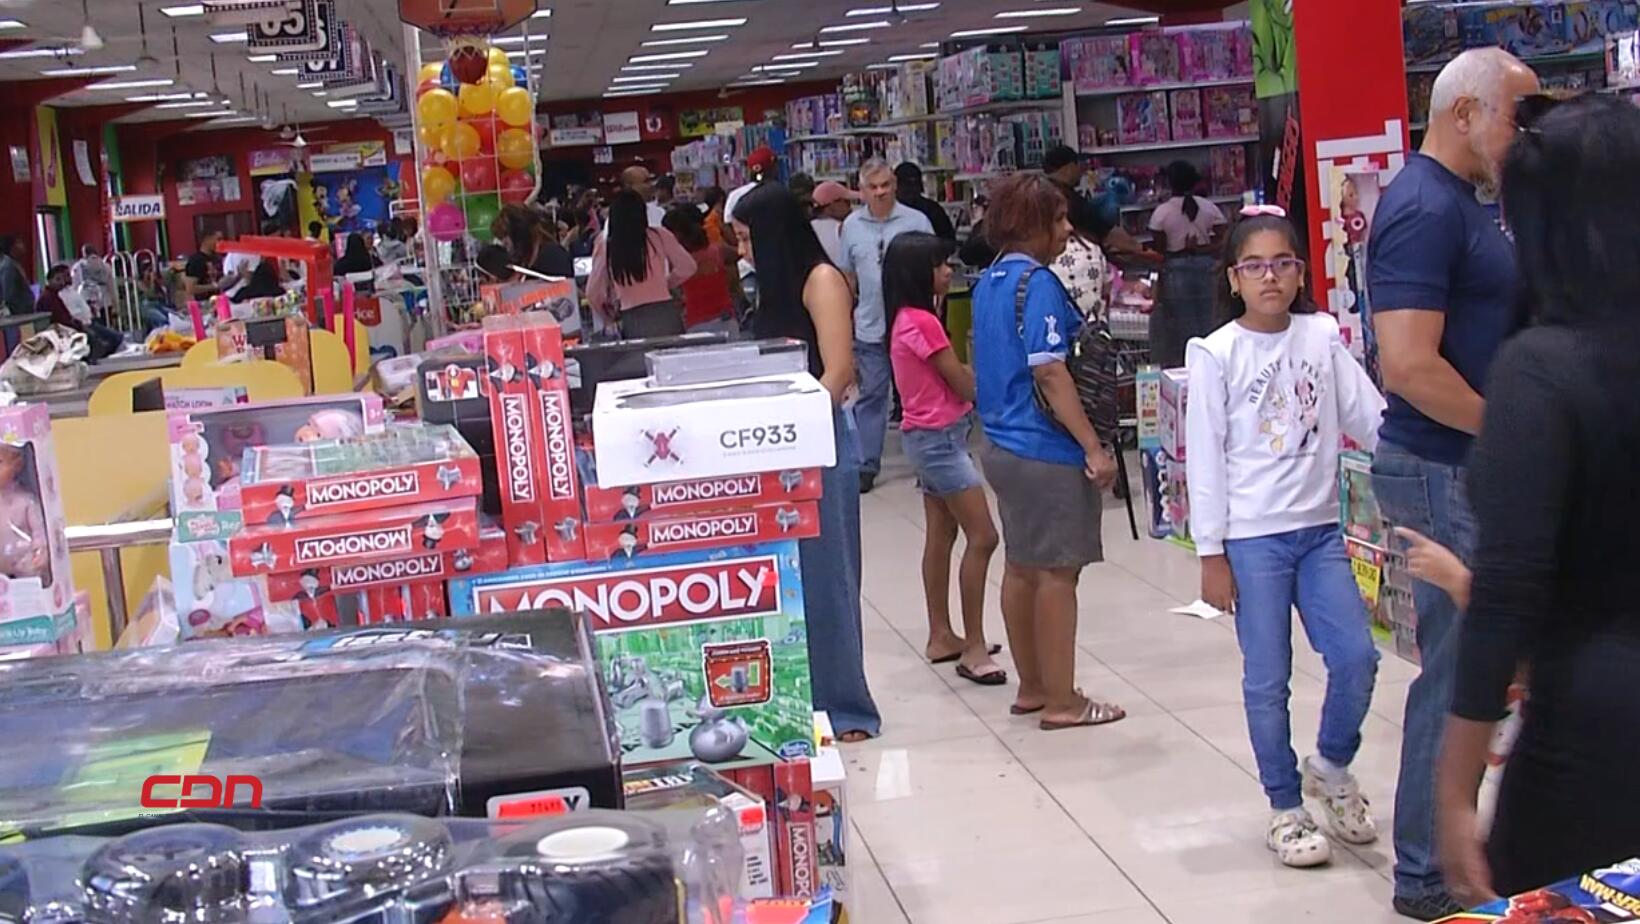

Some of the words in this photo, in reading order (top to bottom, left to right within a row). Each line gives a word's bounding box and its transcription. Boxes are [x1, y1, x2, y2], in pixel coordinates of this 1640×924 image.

[115, 201, 160, 216] SALIDA
[505, 397, 533, 502] MONOPOLY
[545, 395, 572, 497] MONOPOLY
[720, 424, 797, 449] CF933
[310, 475, 414, 505] MONOPOLY
[657, 477, 756, 503] MONOPOLY
[654, 516, 753, 542] MONOPOLY
[301, 531, 409, 561] MONOPOLY
[336, 557, 440, 585] MONOPOLY
